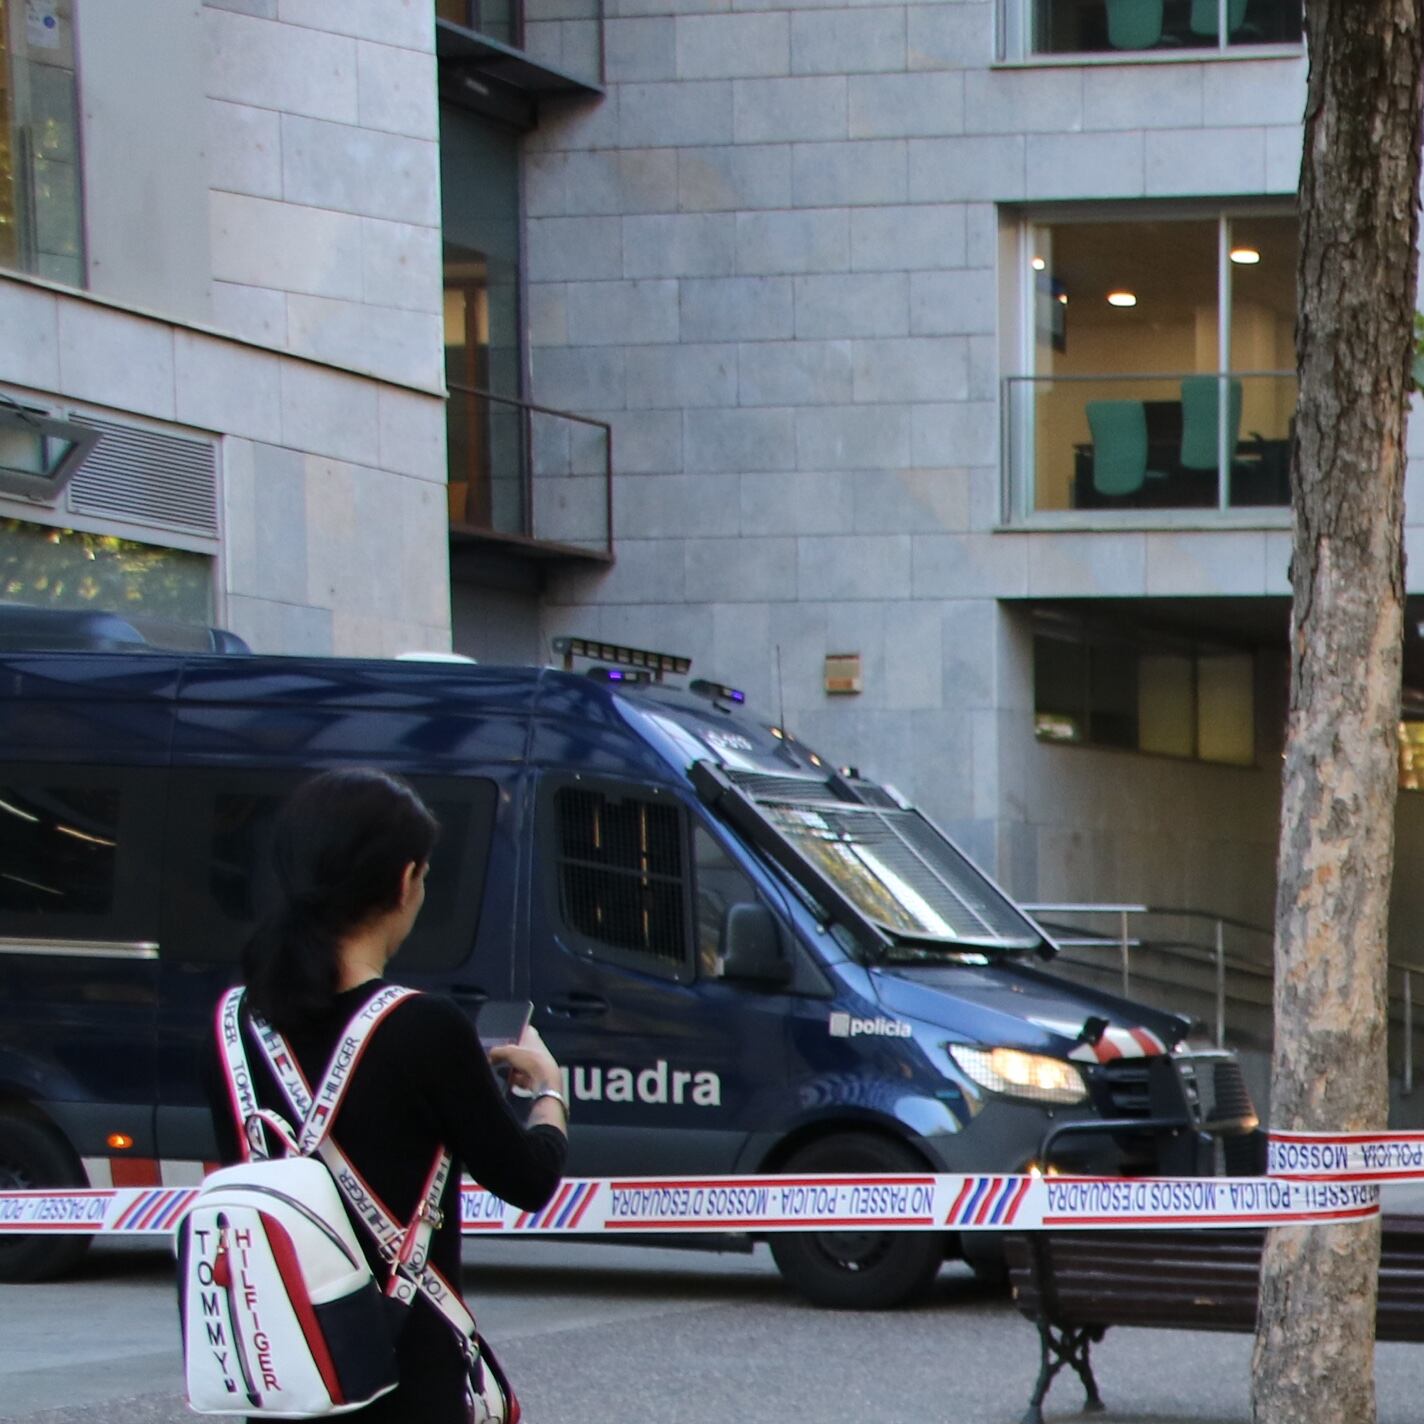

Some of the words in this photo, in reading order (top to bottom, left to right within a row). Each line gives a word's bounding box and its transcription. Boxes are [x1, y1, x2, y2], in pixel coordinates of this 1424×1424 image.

[850, 1014, 912, 1038] policia
[321, 1036, 361, 1103] HILFIGER
[1278, 1143, 1348, 1170] MOSSOS
[1361, 1143, 1422, 1168] POLICIA
[611, 1188, 705, 1218] D'ESQUADRA
[708, 1187, 769, 1216] MOSSOS
[780, 1187, 838, 1215] POLICIA
[850, 1186, 908, 1215] PASSEU
[912, 1186, 935, 1215] NO
[1048, 1181, 1146, 1213] D'ESQUADRA
[1150, 1182, 1217, 1211] MOSSOS
[1230, 1183, 1291, 1210] POLICIA
[195, 1230, 228, 1375] TOMMY
[234, 1228, 283, 1392] HILFIGER
